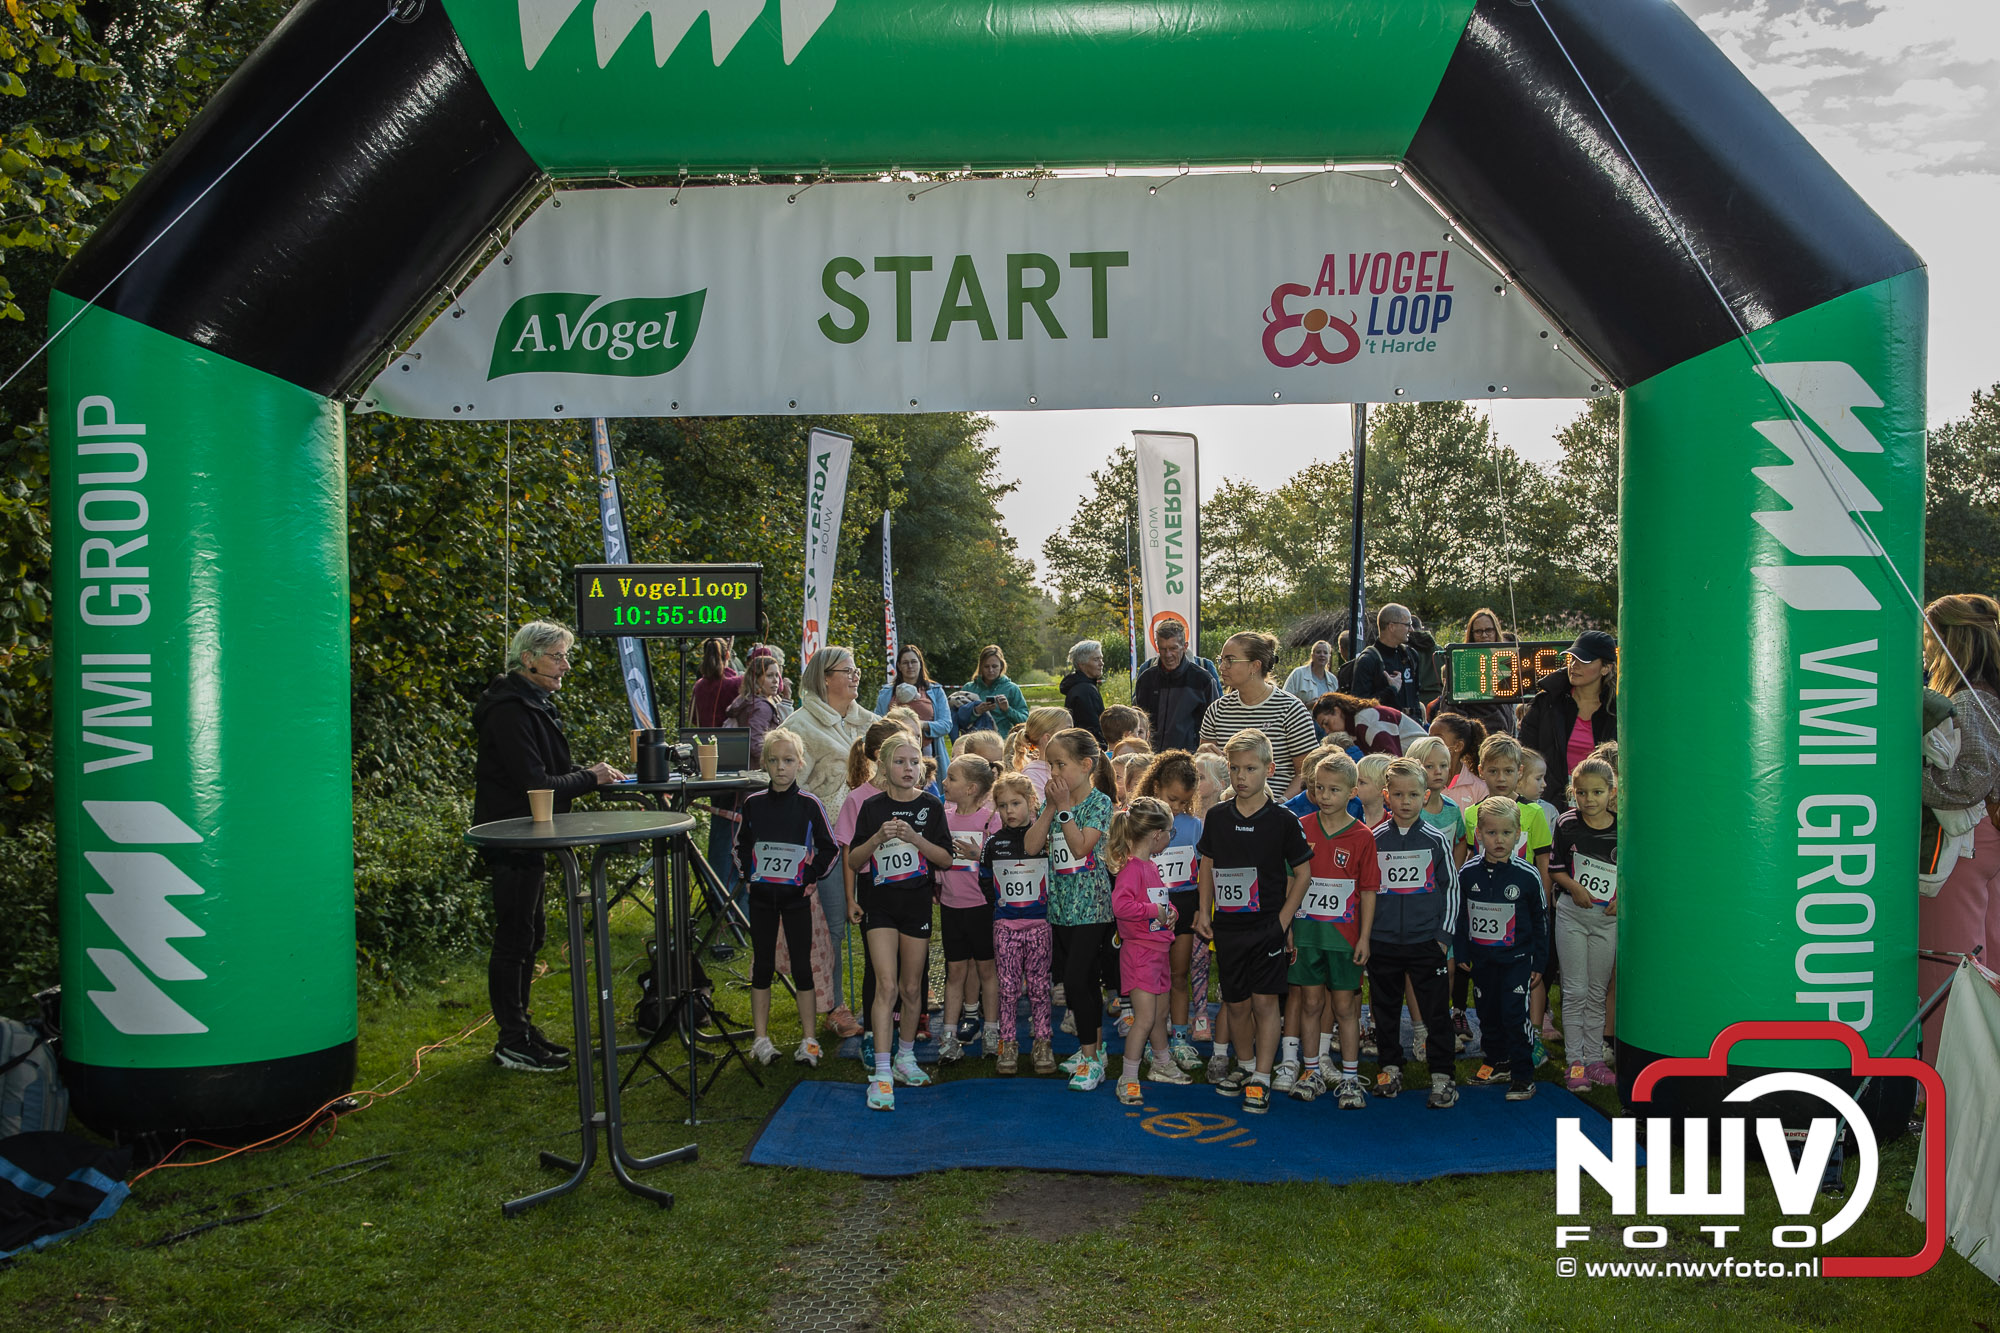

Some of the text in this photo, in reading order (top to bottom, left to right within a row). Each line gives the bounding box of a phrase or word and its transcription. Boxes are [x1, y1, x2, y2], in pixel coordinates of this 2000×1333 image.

[1313, 250, 1455, 296] A.VOGEL
[819, 251, 1131, 344] START
[1367, 294, 1453, 336] LOOP
[511, 302, 680, 361] A.Vogel
[1381, 337, 1437, 354] Harde
[821, 507, 833, 554] BOUW
[76, 395, 154, 775] VMI GROUP
[588, 577, 749, 601] A Vogelloop
[613, 605, 727, 626] 10:55:00
[1794, 637, 1878, 1032] VMI GROUP
[763, 857, 792, 873] 737
[882, 852, 912, 871] 709
[1158, 862, 1184, 878] 677
[1388, 867, 1420, 882] 622
[1578, 873, 1611, 894] 663
[1005, 881, 1032, 897] 691
[1217, 885, 1243, 900] 785
[1309, 893, 1340, 910] 749
[1472, 917, 1499, 934] 623
